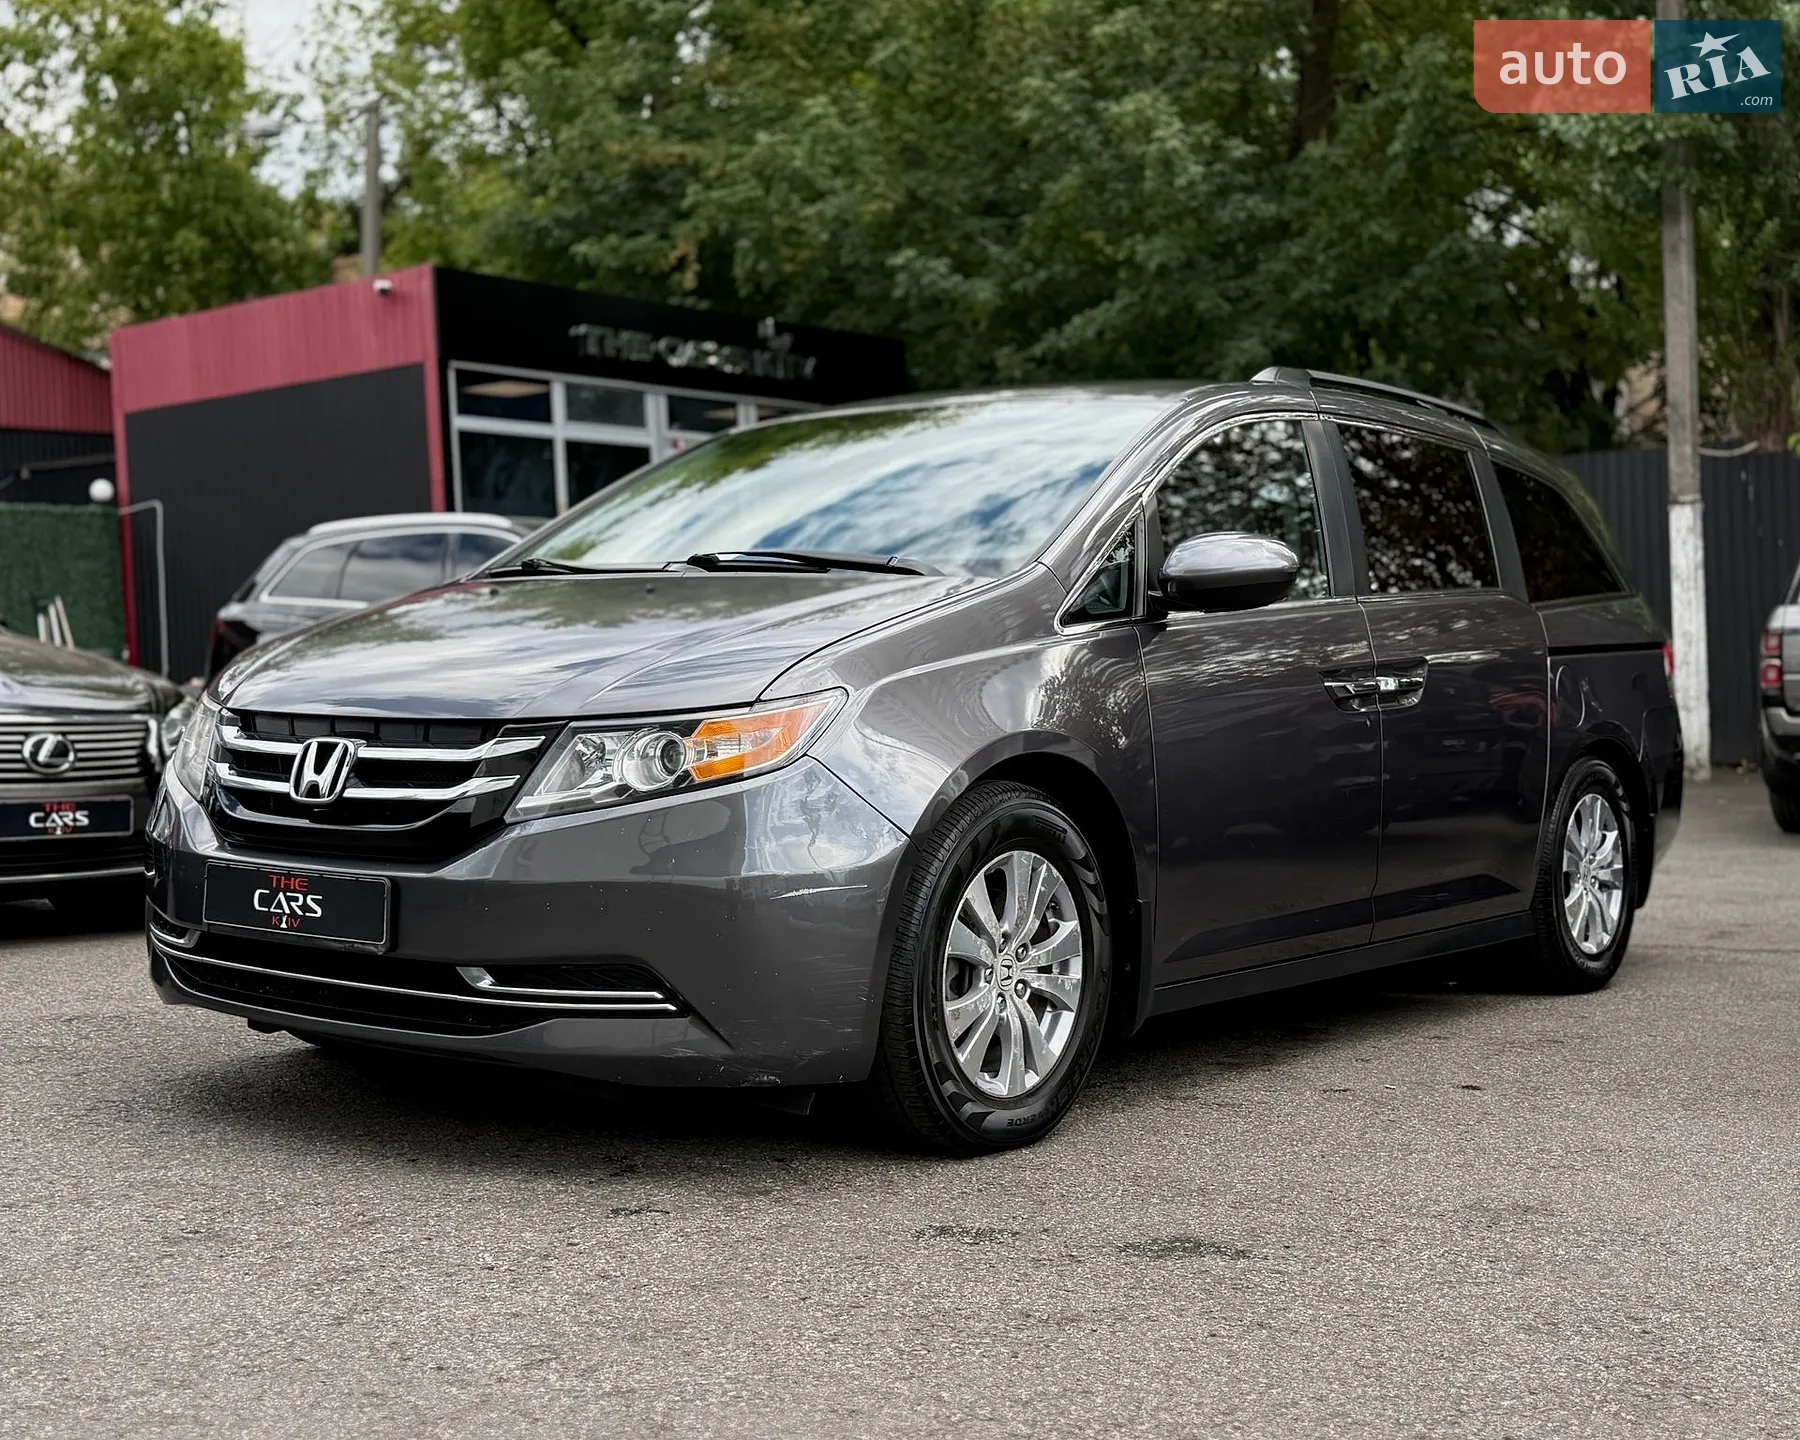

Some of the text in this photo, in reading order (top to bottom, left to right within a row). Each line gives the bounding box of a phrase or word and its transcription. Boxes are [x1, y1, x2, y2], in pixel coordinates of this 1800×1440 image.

[28, 810, 90, 828] CARS
[269, 874, 309, 891] THE
[253, 888, 323, 918] CARS
